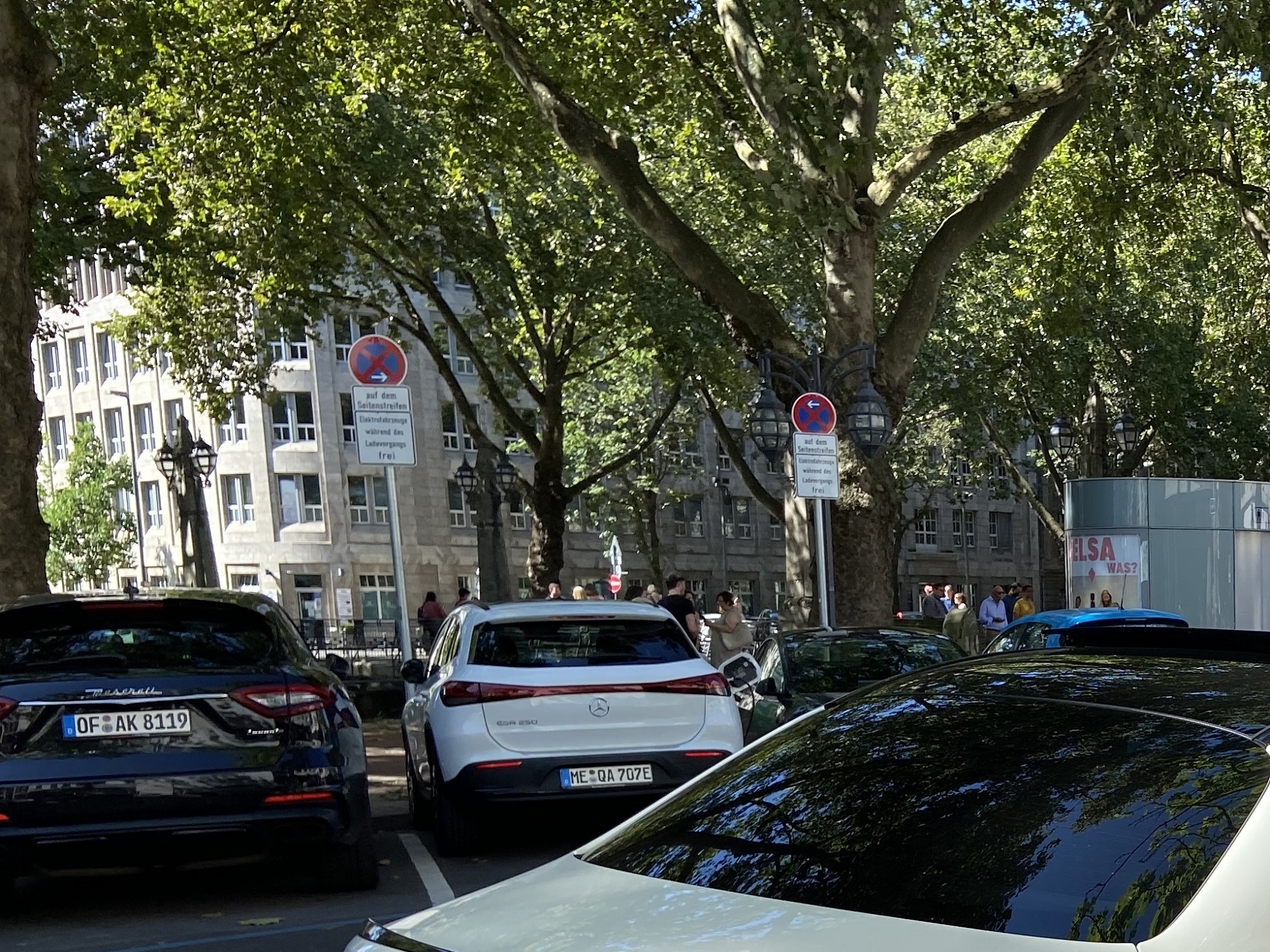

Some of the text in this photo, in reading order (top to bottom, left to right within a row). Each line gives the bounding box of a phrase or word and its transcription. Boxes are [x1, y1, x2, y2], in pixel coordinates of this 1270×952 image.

[366, 391, 397, 400] auf dem
[357, 401, 407, 410] Seitenstreifen
[365, 428, 391, 436] während
[797, 446, 835, 454] Seitenstreifen
[378, 451, 396, 460] frei
[1106, 562, 1138, 574] WAS?
[77, 712, 188, 733] OF AK 8119
[570, 767, 651, 784] ME QA 707E
